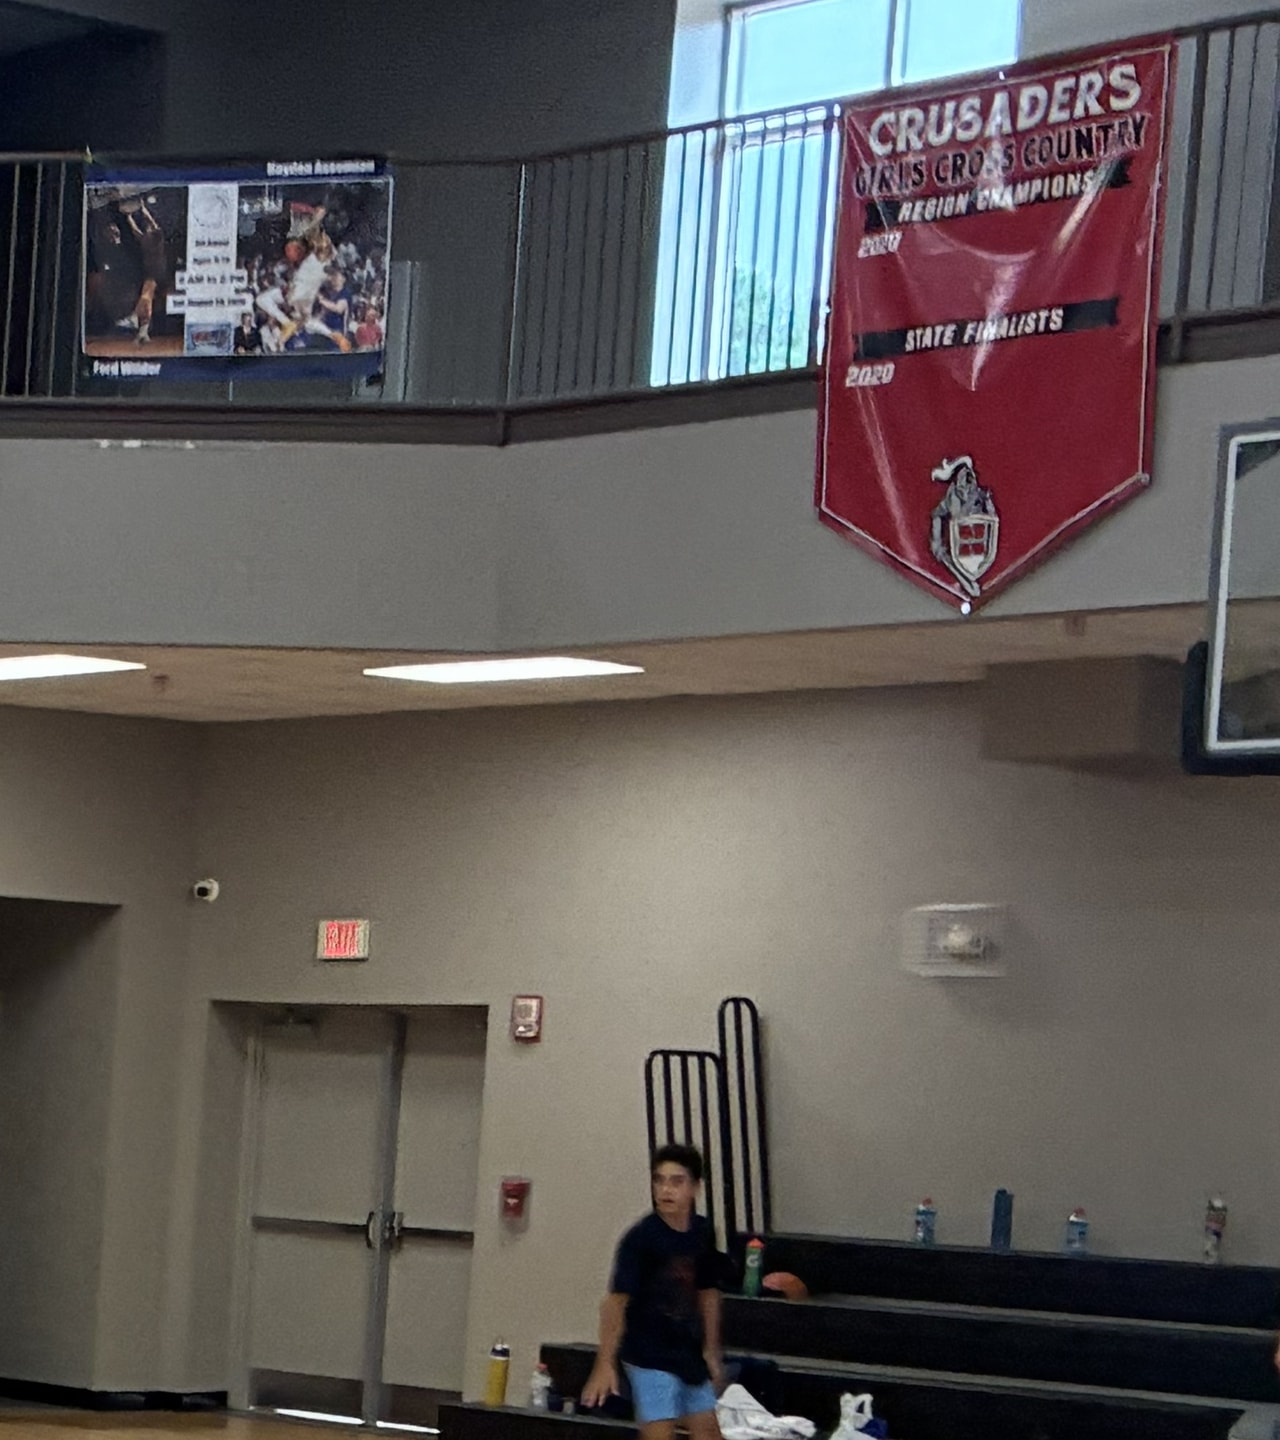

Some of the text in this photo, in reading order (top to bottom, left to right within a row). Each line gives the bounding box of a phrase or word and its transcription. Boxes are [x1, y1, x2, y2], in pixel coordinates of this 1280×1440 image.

[869, 64, 1140, 157] CRUSADERS
[1021, 114, 1148, 170] COUNTRY
[897, 171, 1096, 224] REGION CHAMPIONS
[905, 307, 1065, 352] STATE FINALISTS
[845, 362, 896, 388] 2020
